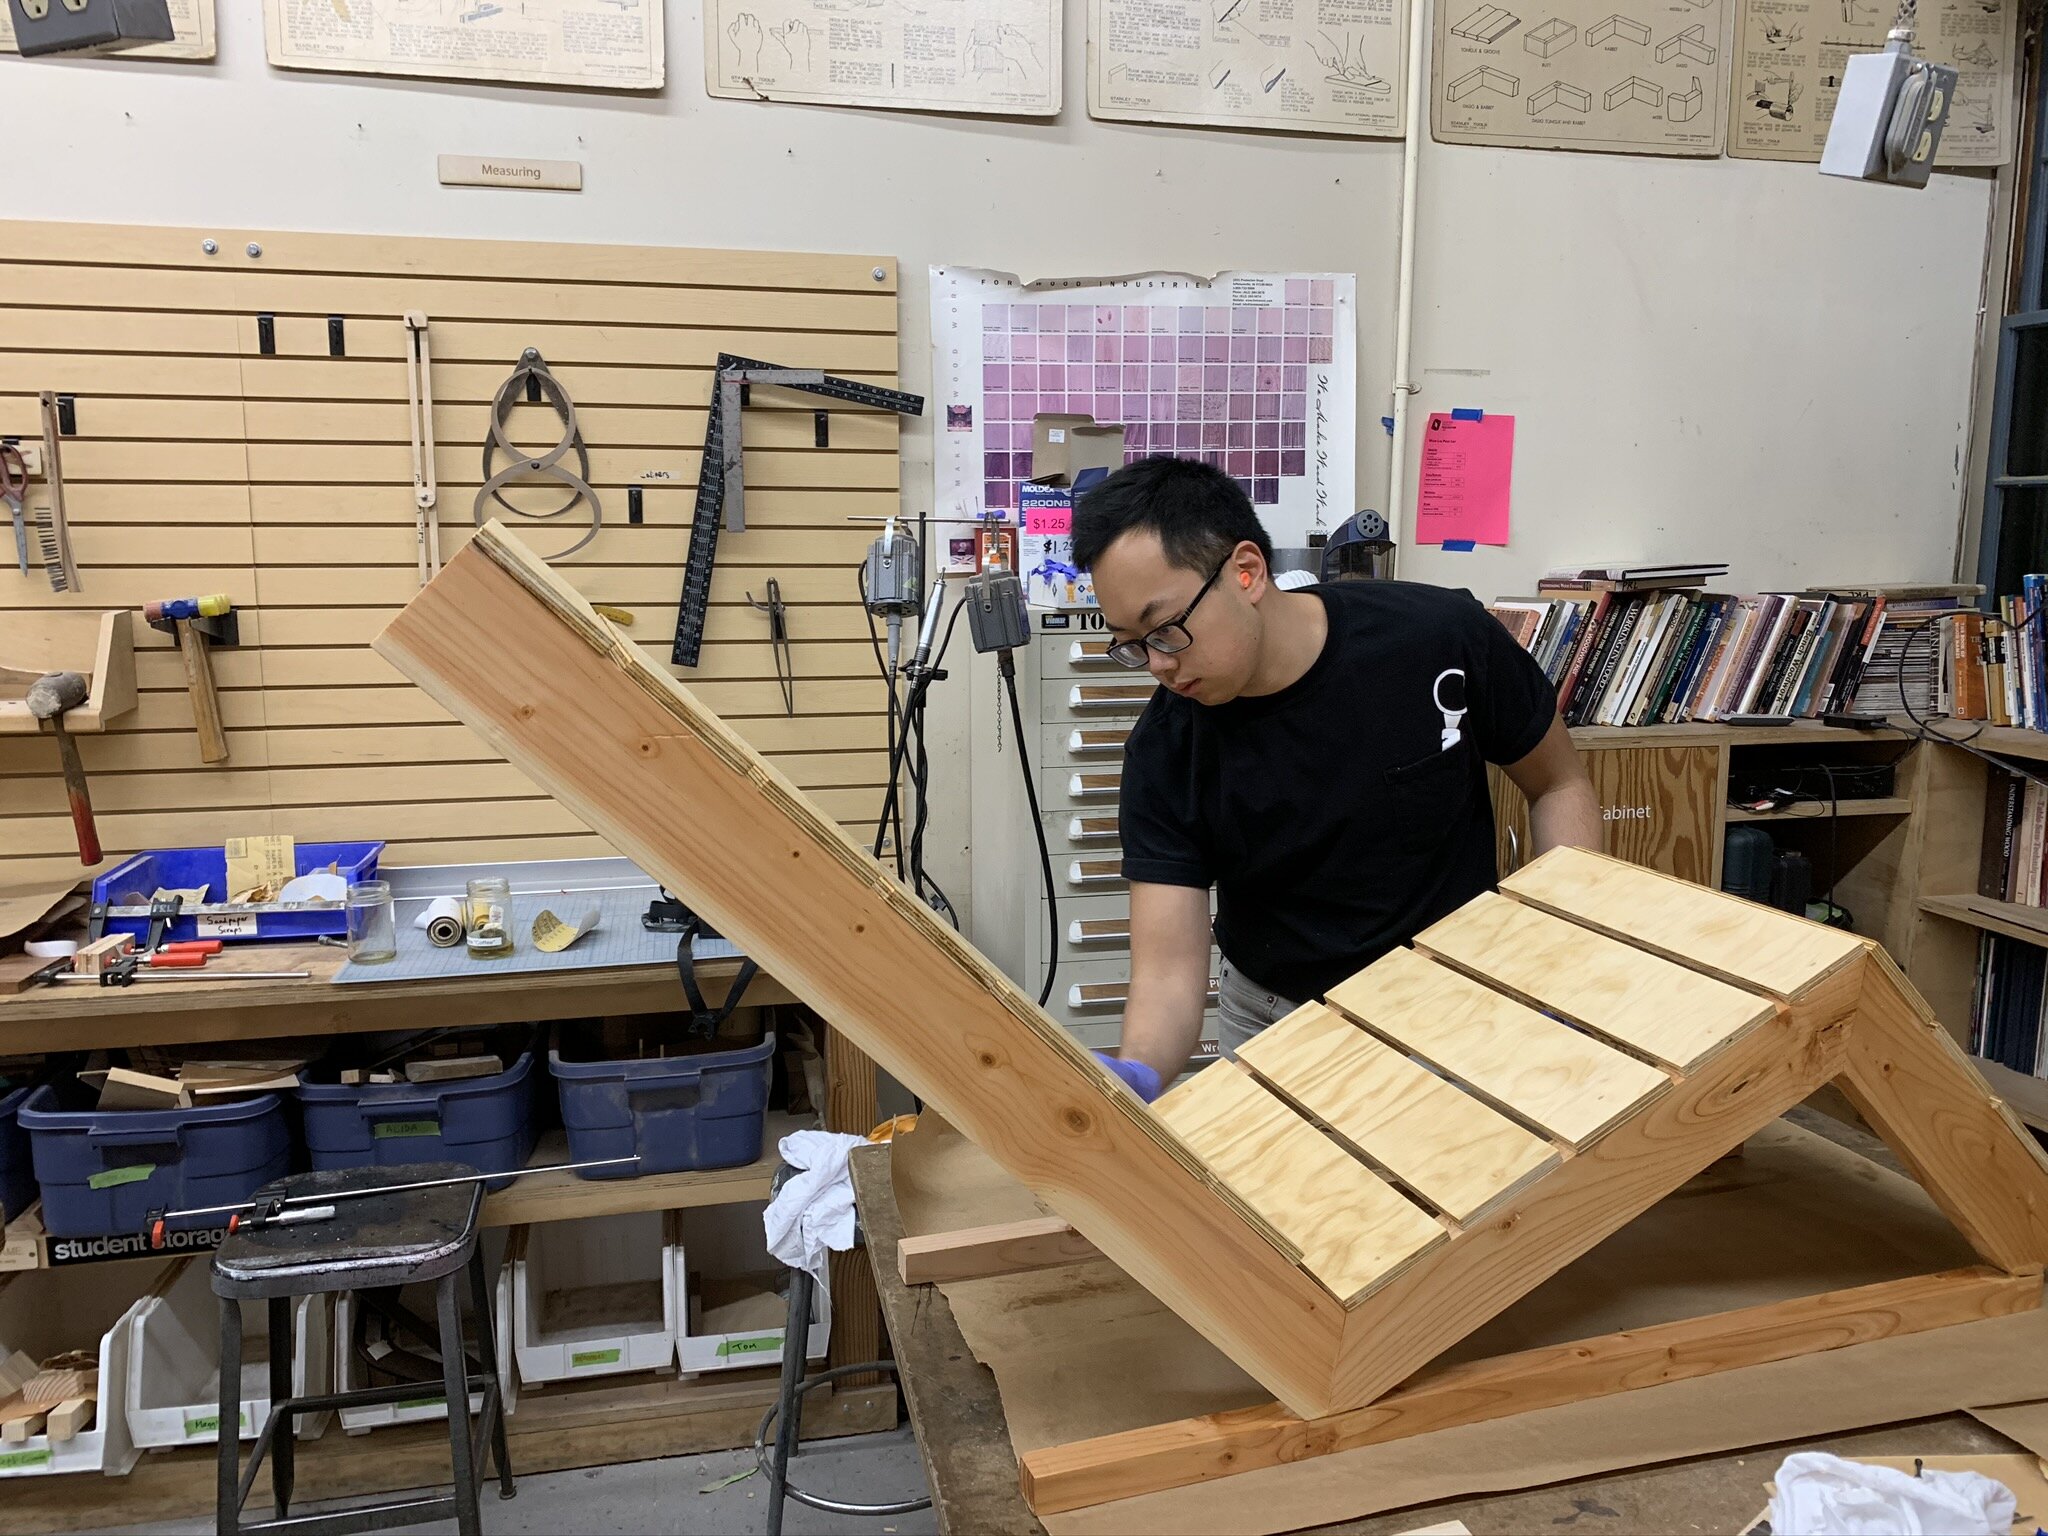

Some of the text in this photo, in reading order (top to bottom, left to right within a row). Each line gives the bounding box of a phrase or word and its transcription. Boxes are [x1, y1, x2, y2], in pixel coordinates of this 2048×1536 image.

[481, 164, 541, 180] Measuring
[1033, 518, 1066, 530] $1.25
[1795, 627, 1813, 657] Bench
[1596, 659, 1616, 689] WOOD
[1774, 656, 1800, 704] Woodwork
[1600, 804, 1652, 821] abinet
[2003, 783, 2016, 858] UNDERSTANDING WOOD
[206, 916, 249, 926] Sandpaper
[217, 926, 242, 935] Scraps
[54, 1226, 229, 1260] student torag
[731, 1342, 758, 1352] TOM
